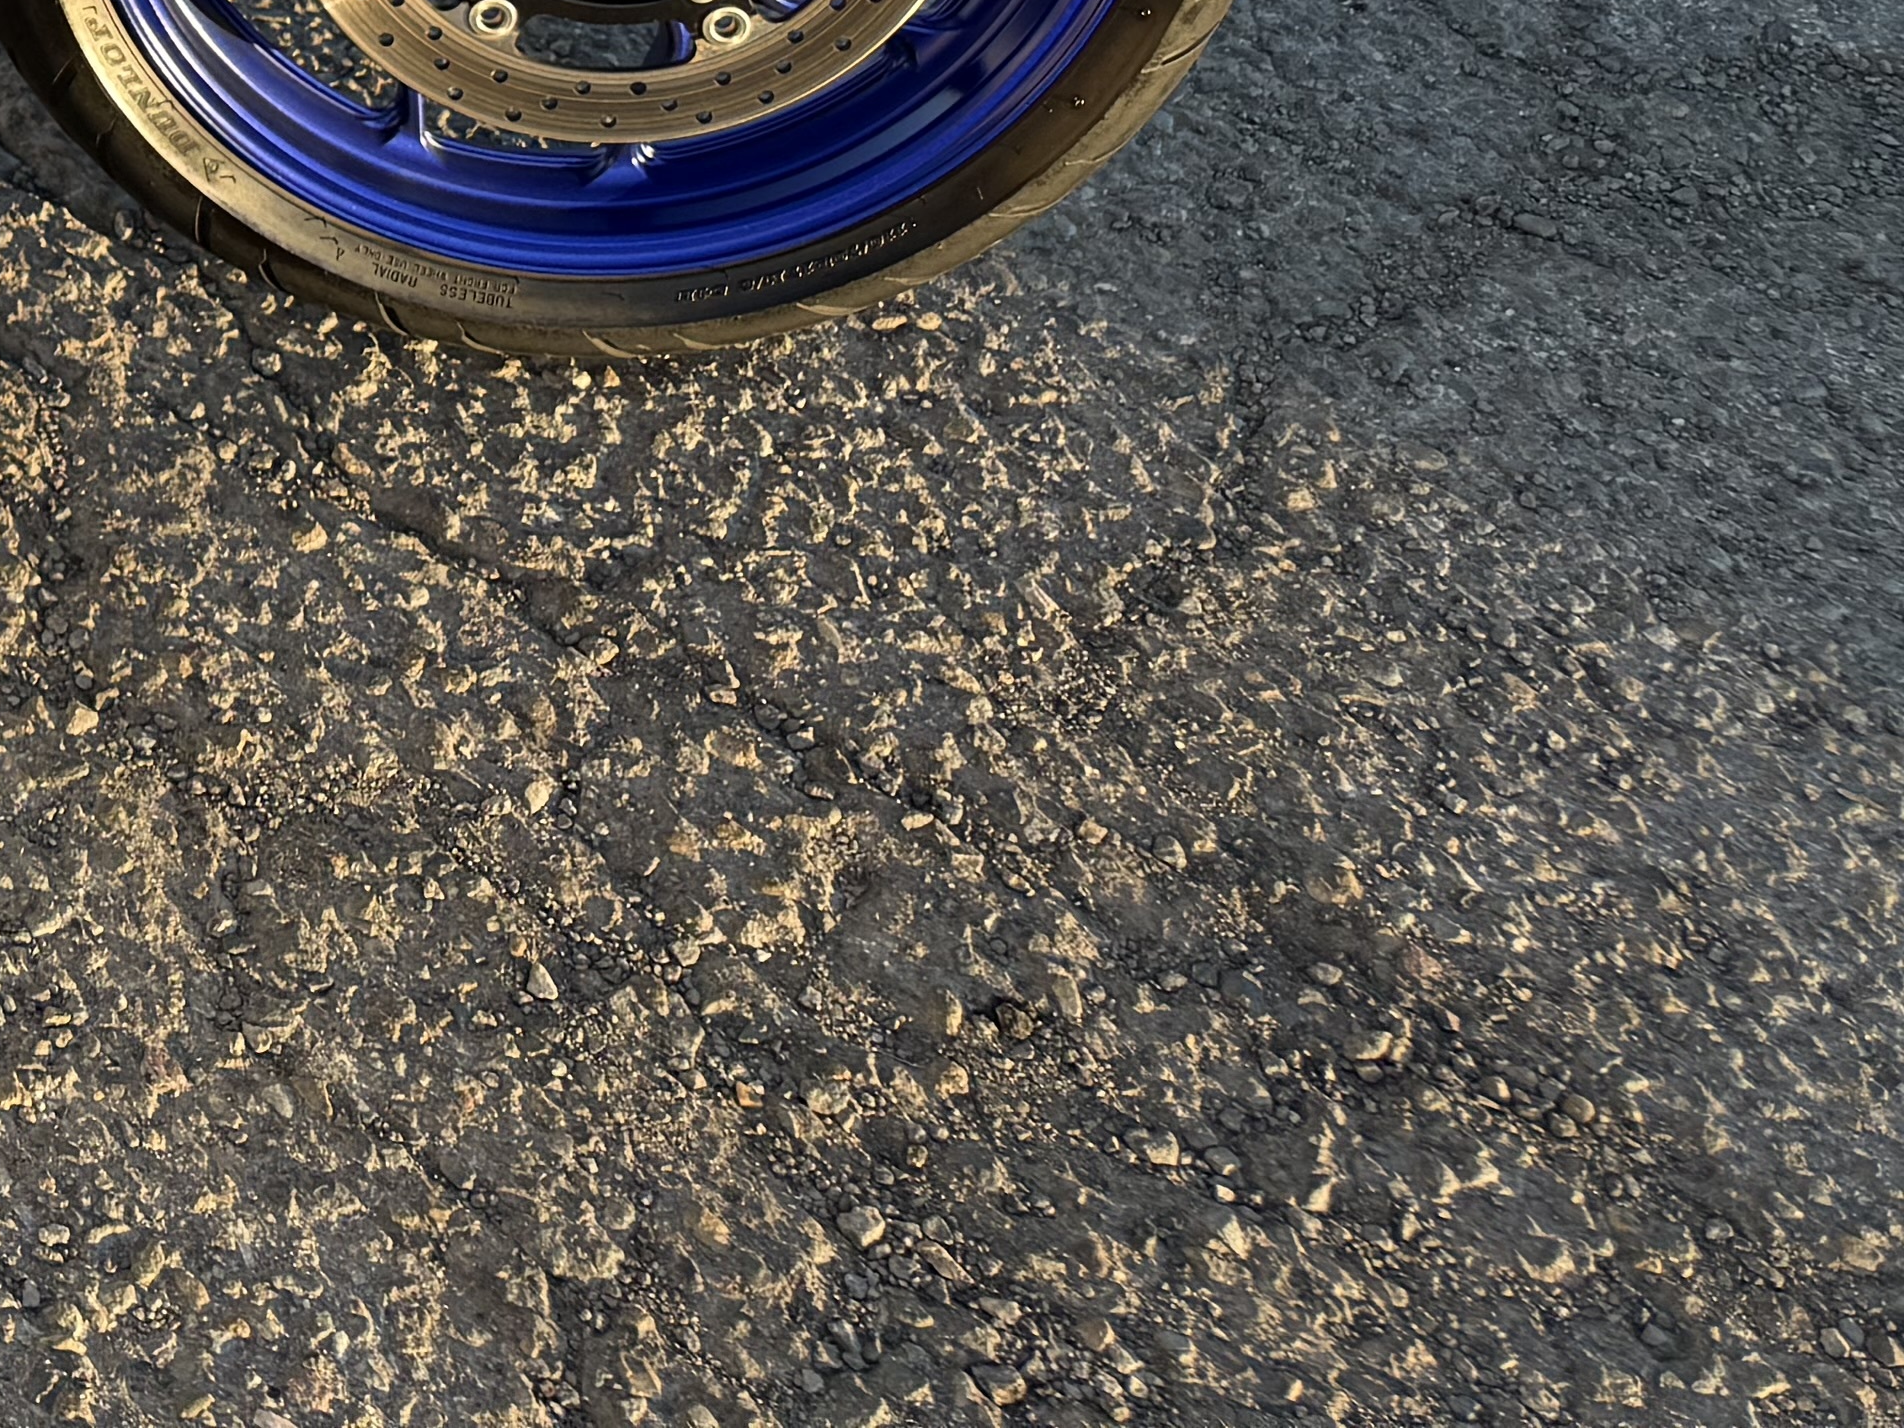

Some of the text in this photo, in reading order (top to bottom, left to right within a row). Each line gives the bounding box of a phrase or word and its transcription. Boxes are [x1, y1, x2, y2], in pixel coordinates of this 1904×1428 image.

[84, 15, 201, 156] DUNLOP
[372, 262, 513, 309] TUBELESS RADIAL
